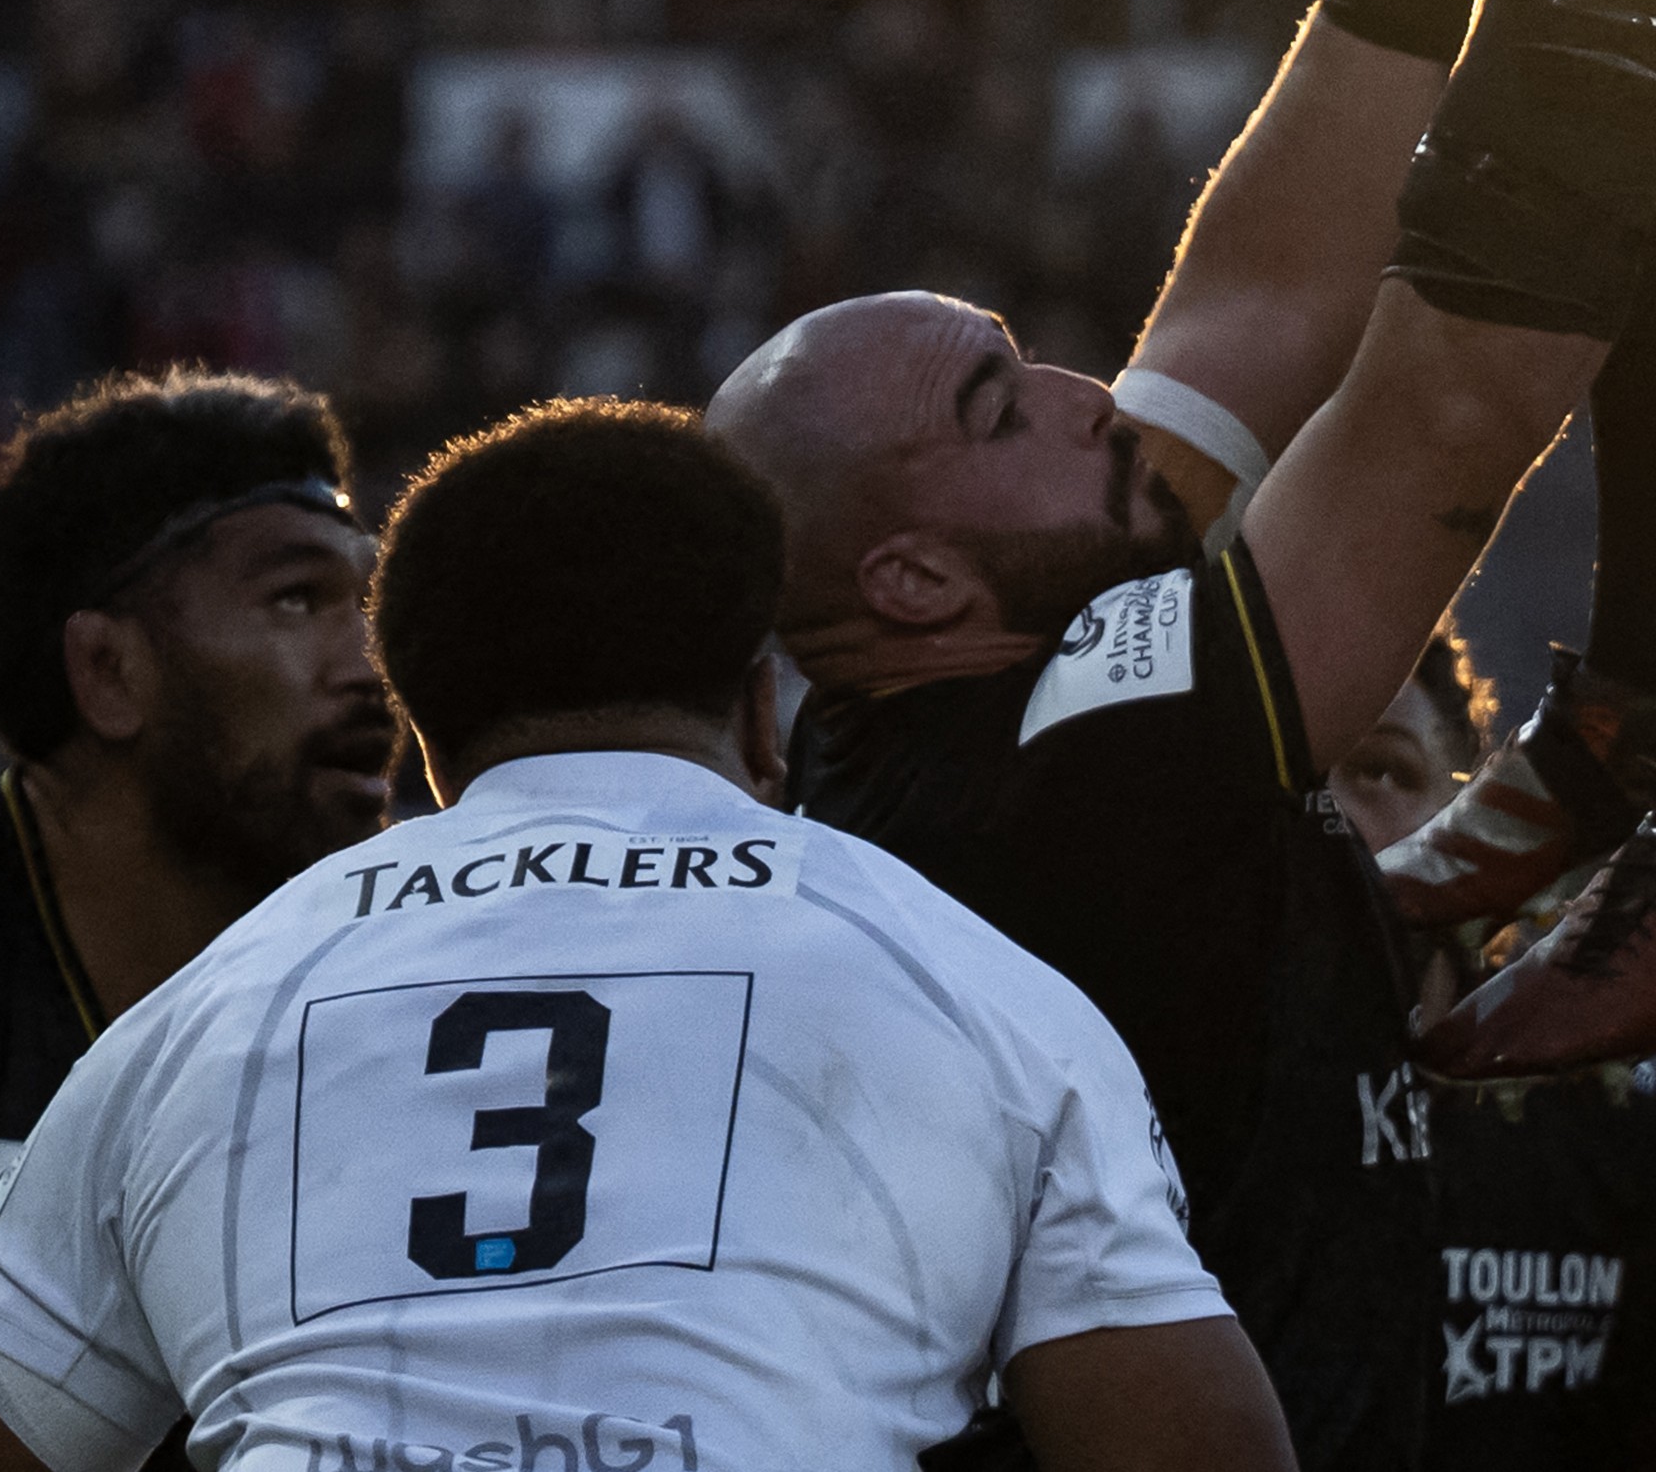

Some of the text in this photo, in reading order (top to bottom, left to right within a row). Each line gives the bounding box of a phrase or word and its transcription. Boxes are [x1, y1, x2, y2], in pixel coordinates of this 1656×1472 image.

[344, 838, 778, 919] TACKLERS
[407, 990, 612, 1280] 3
[1441, 1247, 1624, 1305] TOULON
[1486, 1335, 1606, 1392] TPM
